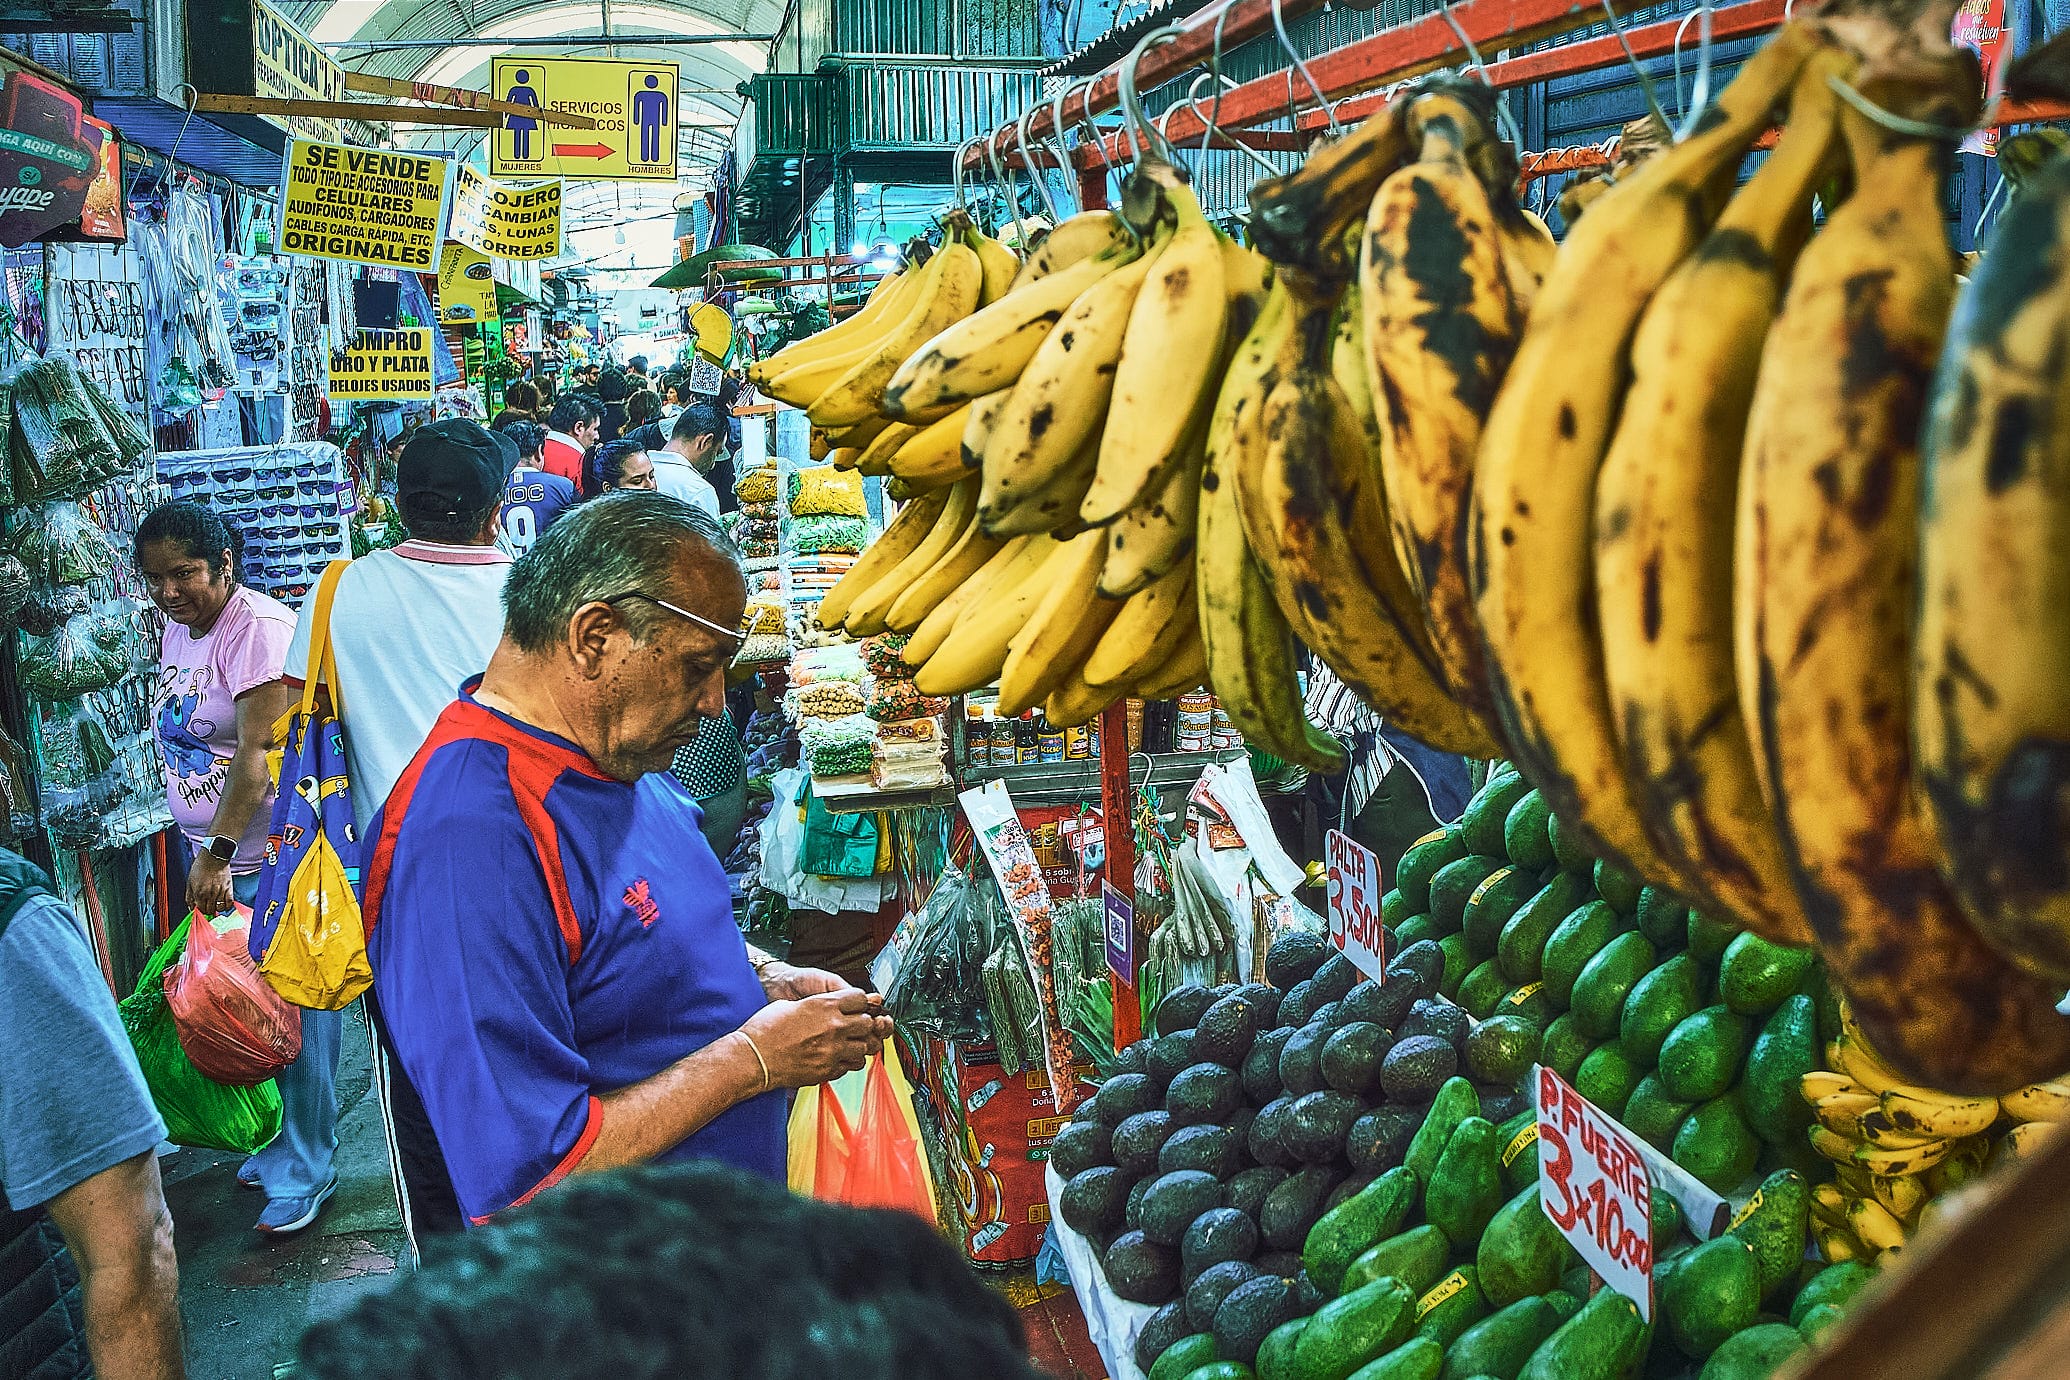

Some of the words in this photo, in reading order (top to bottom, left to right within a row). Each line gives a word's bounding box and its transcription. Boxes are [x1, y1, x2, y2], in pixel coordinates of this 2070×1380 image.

[1960, 21, 2000, 41] resuelven
[258, 8, 319, 92] OPTICA
[550, 101, 623, 115] SERVICIOS
[22, 139, 56, 155] AQUÍ
[306, 145, 339, 169] SE
[346, 150, 431, 182] VENDE
[500, 163, 542, 172] MUJERES
[628, 166, 672, 175] HOMBRES
[292, 166, 317, 185] TODO
[320, 170, 341, 188] TIPO
[342, 173, 356, 190] DE
[357, 174, 415, 198] ACCESORIOS
[416, 182, 440, 201] PARA
[463, 170, 561, 209] RELOJERO
[0, 187, 55, 217] yape
[315, 187, 414, 213] CELULARES
[458, 190, 476, 209] SE
[482, 204, 560, 225] CAMBIAN
[288, 200, 358, 224] AUDIFONOS,
[360, 209, 436, 232] CARGADORES
[286, 217, 328, 234] CABLES
[329, 224, 365, 239] CARGA
[367, 227, 408, 247] RÁPIDA,
[410, 233, 433, 248] ETC.
[506, 223, 555, 239] LUNAS
[284, 231, 431, 265] ORIGINALES
[471, 234, 556, 257] CORREAS
[348, 331, 422, 351] OMPRO
[330, 355, 365, 373] ORO
[368, 355, 379, 373] Y
[382, 355, 430, 373] PLATA
[329, 379, 379, 393] RELOJES
[381, 379, 431, 392] USADOS
[177, 766, 227, 810] Happy
[1329, 831, 1366, 890] PALTA
